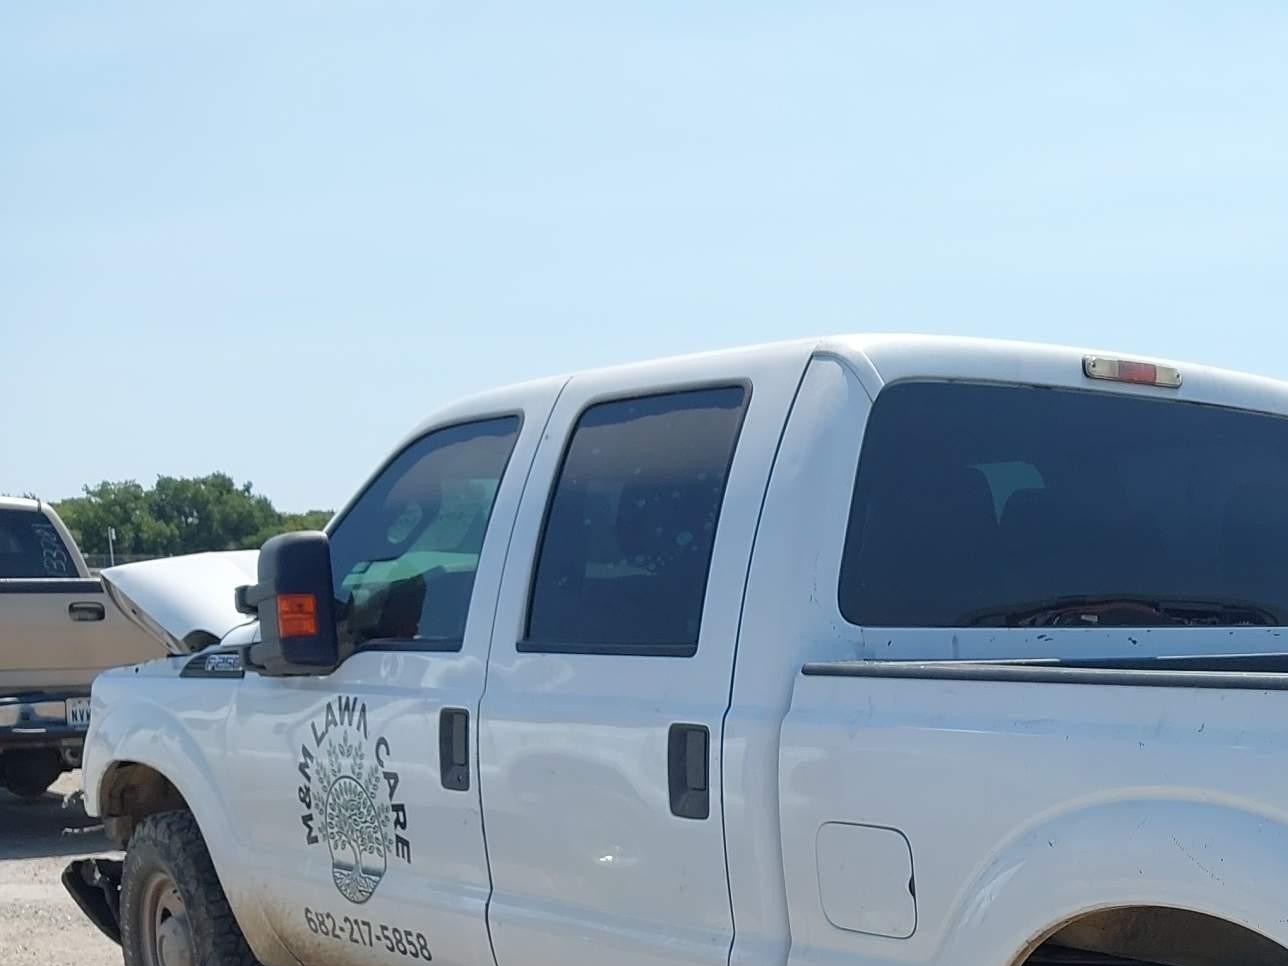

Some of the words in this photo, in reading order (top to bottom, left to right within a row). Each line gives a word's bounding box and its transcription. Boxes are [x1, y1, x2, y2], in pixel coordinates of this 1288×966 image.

[298, 744, 319, 845] M&M
[375, 736, 411, 864] CARE
[304, 907, 432, 961] 682-217-5858
